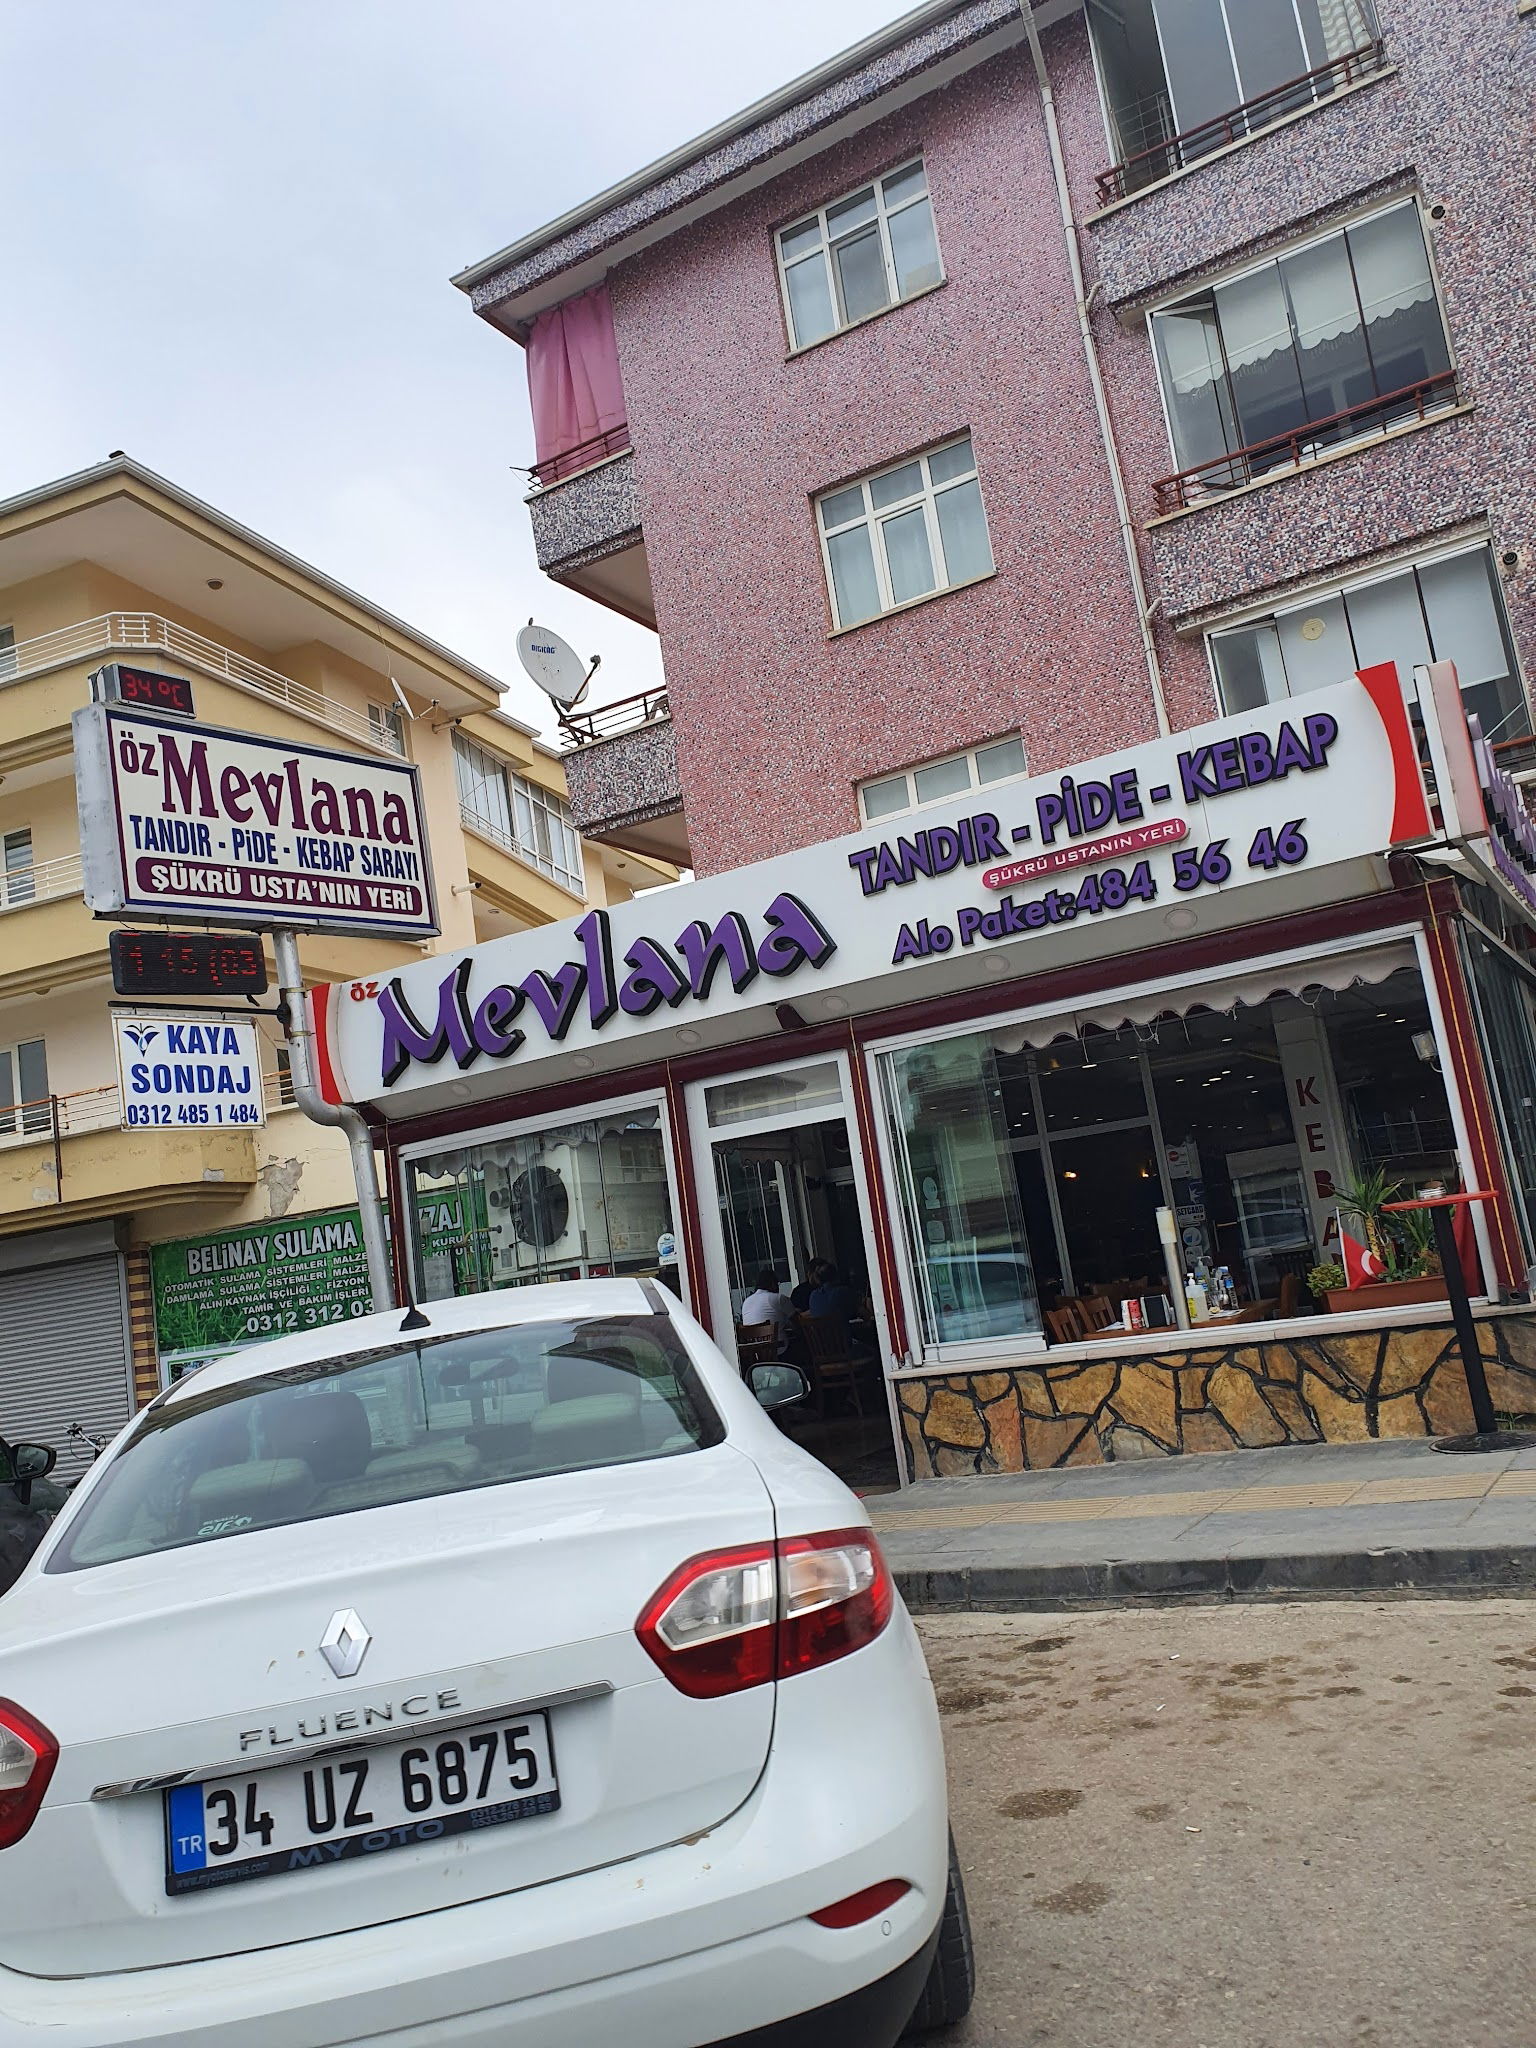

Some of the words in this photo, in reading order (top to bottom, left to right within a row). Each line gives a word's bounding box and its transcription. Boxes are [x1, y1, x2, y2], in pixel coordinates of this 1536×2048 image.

[122, 672, 152, 698] 34
[119, 730, 159, 777] ÖZ
[157, 733, 415, 846] Mevlana
[848, 811, 1012, 897] TANDIR
[1035, 768, 1144, 846] PİDE
[1176, 712, 1339, 805] KEBAP
[129, 814, 213, 858] TANDIR
[296, 836, 355, 873] KEBAP
[360, 844, 420, 882] SARAYI
[989, 856, 1049, 886] ŞÜKRÜ
[1054, 836, 1132, 866] USTANIN
[1138, 819, 1182, 842] YERİ
[150, 861, 242, 894] ŞÜKRÜ
[250, 873, 361, 906] USTA'NIN
[366, 886, 414, 911] YERİ
[892, 917, 954, 966] Alo
[1172, 838, 1230, 893] 56
[1247, 817, 1309, 871] 46
[350, 982, 380, 1002] ÖZ
[377, 891, 838, 1088] Mevlana
[167, 1024, 241, 1056] KAYA
[131, 1063, 251, 1094] SONDAJ
[127, 1104, 172, 1125] 0312
[178, 1104, 209, 1124] 485
[229, 1103, 259, 1123] 484
[273, 1220, 359, 1261] SULAMA
[164, 1278, 214, 1294] OTOMATİK
[220, 1270, 261, 1284] SULAMA
[266, 1258, 327, 1277] SİSTEMLERİ
[333, 1252, 368, 1266] MALZE
[166, 1289, 214, 1305] DAMLAMA
[220, 1282, 260, 1296] SULAMA
[266, 1270, 327, 1288] SİSTEMLERİ
[333, 1263, 369, 1278] MALZE
[199, 1299, 222, 1311] ALIN
[225, 1292, 267, 1306] KAYNAK
[326, 1275, 365, 1290] FİZYON
[242, 1301, 275, 1316] TAMİR
[279, 1300, 293, 1309] VE
[298, 1293, 332, 1307] BAKIM
[335, 1286, 369, 1301] İŞLERİ
[246, 1310, 299, 1334] 0312
[304, 1303, 345, 1325] 312
[239, 1686, 462, 1752] FLUENCE
[177, 1833, 204, 1856] TR
[205, 1782, 275, 1857] 34
[303, 1758, 374, 1835] UZ
[400, 1725, 539, 1813] 6875
[287, 1840, 348, 1871] MY
[361, 1818, 445, 1854] OTO
